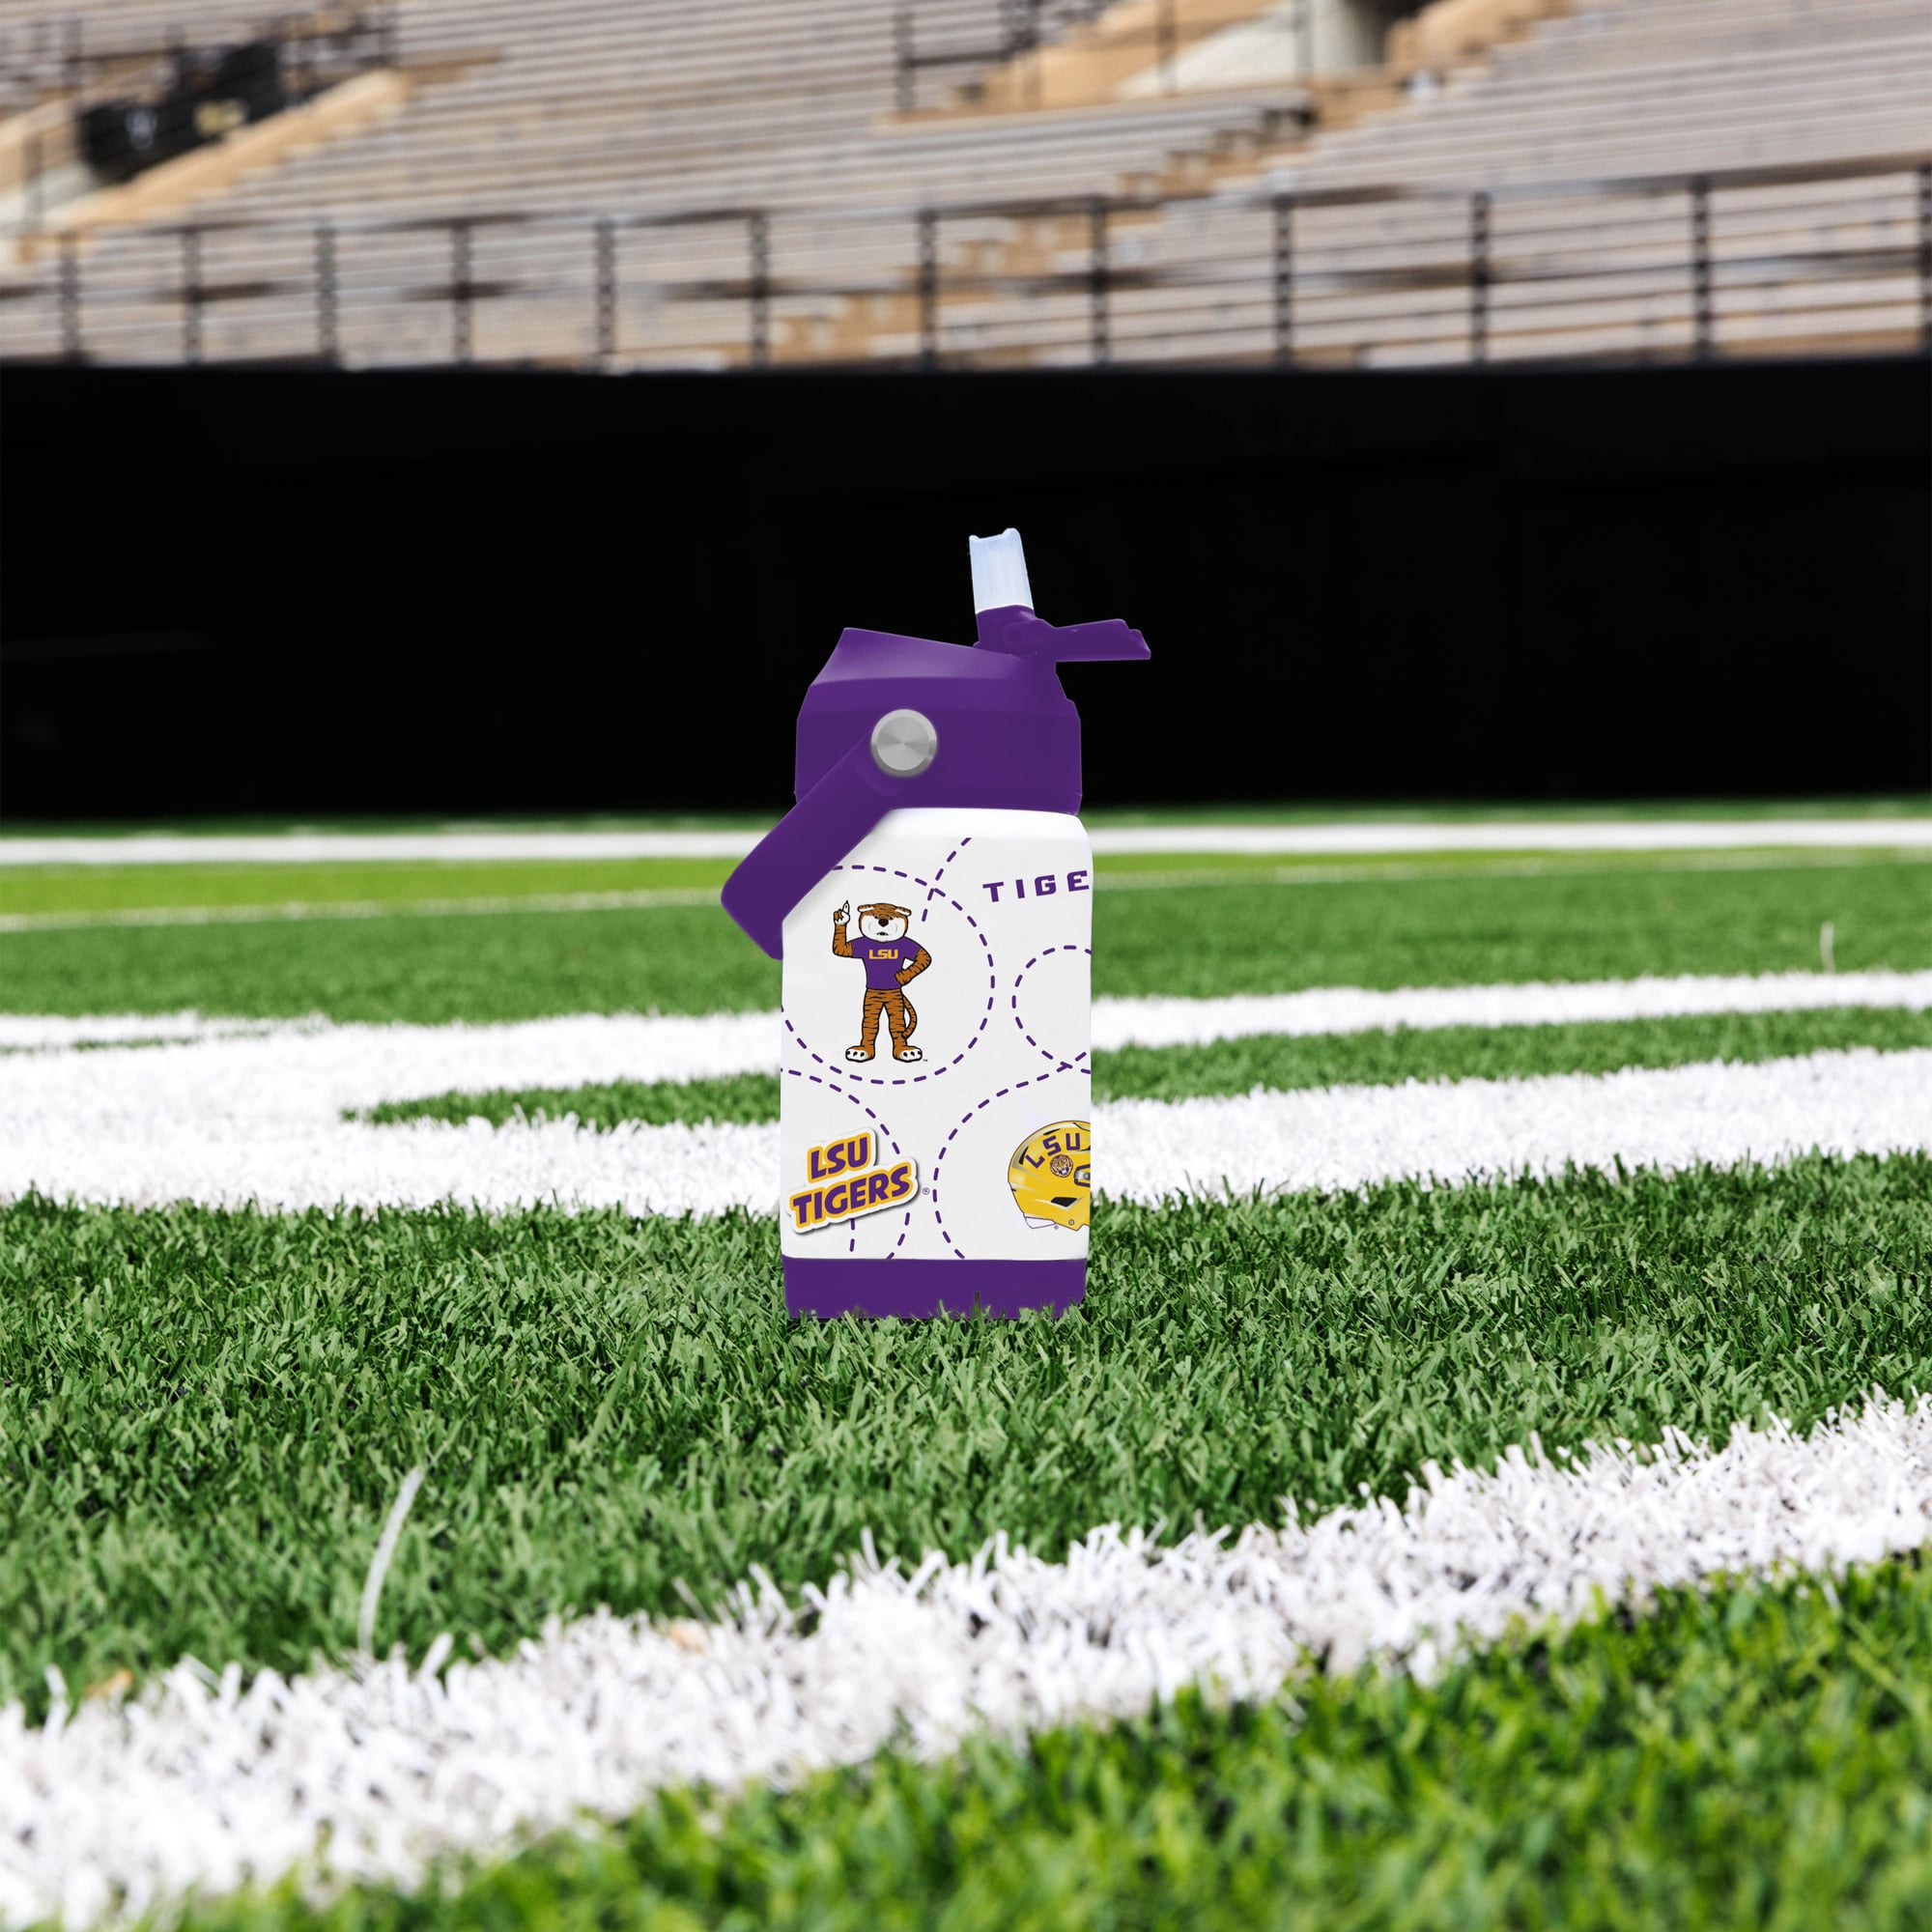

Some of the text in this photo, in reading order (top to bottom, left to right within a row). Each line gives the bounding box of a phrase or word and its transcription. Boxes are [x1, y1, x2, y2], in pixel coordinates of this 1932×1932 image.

[982, 870, 1090, 902] TIGE
[869, 949, 898, 959] LSU
[810, 1134, 869, 1181] LSU
[1025, 1132, 1081, 1169] LSU
[791, 1163, 912, 1226] TIGERS
